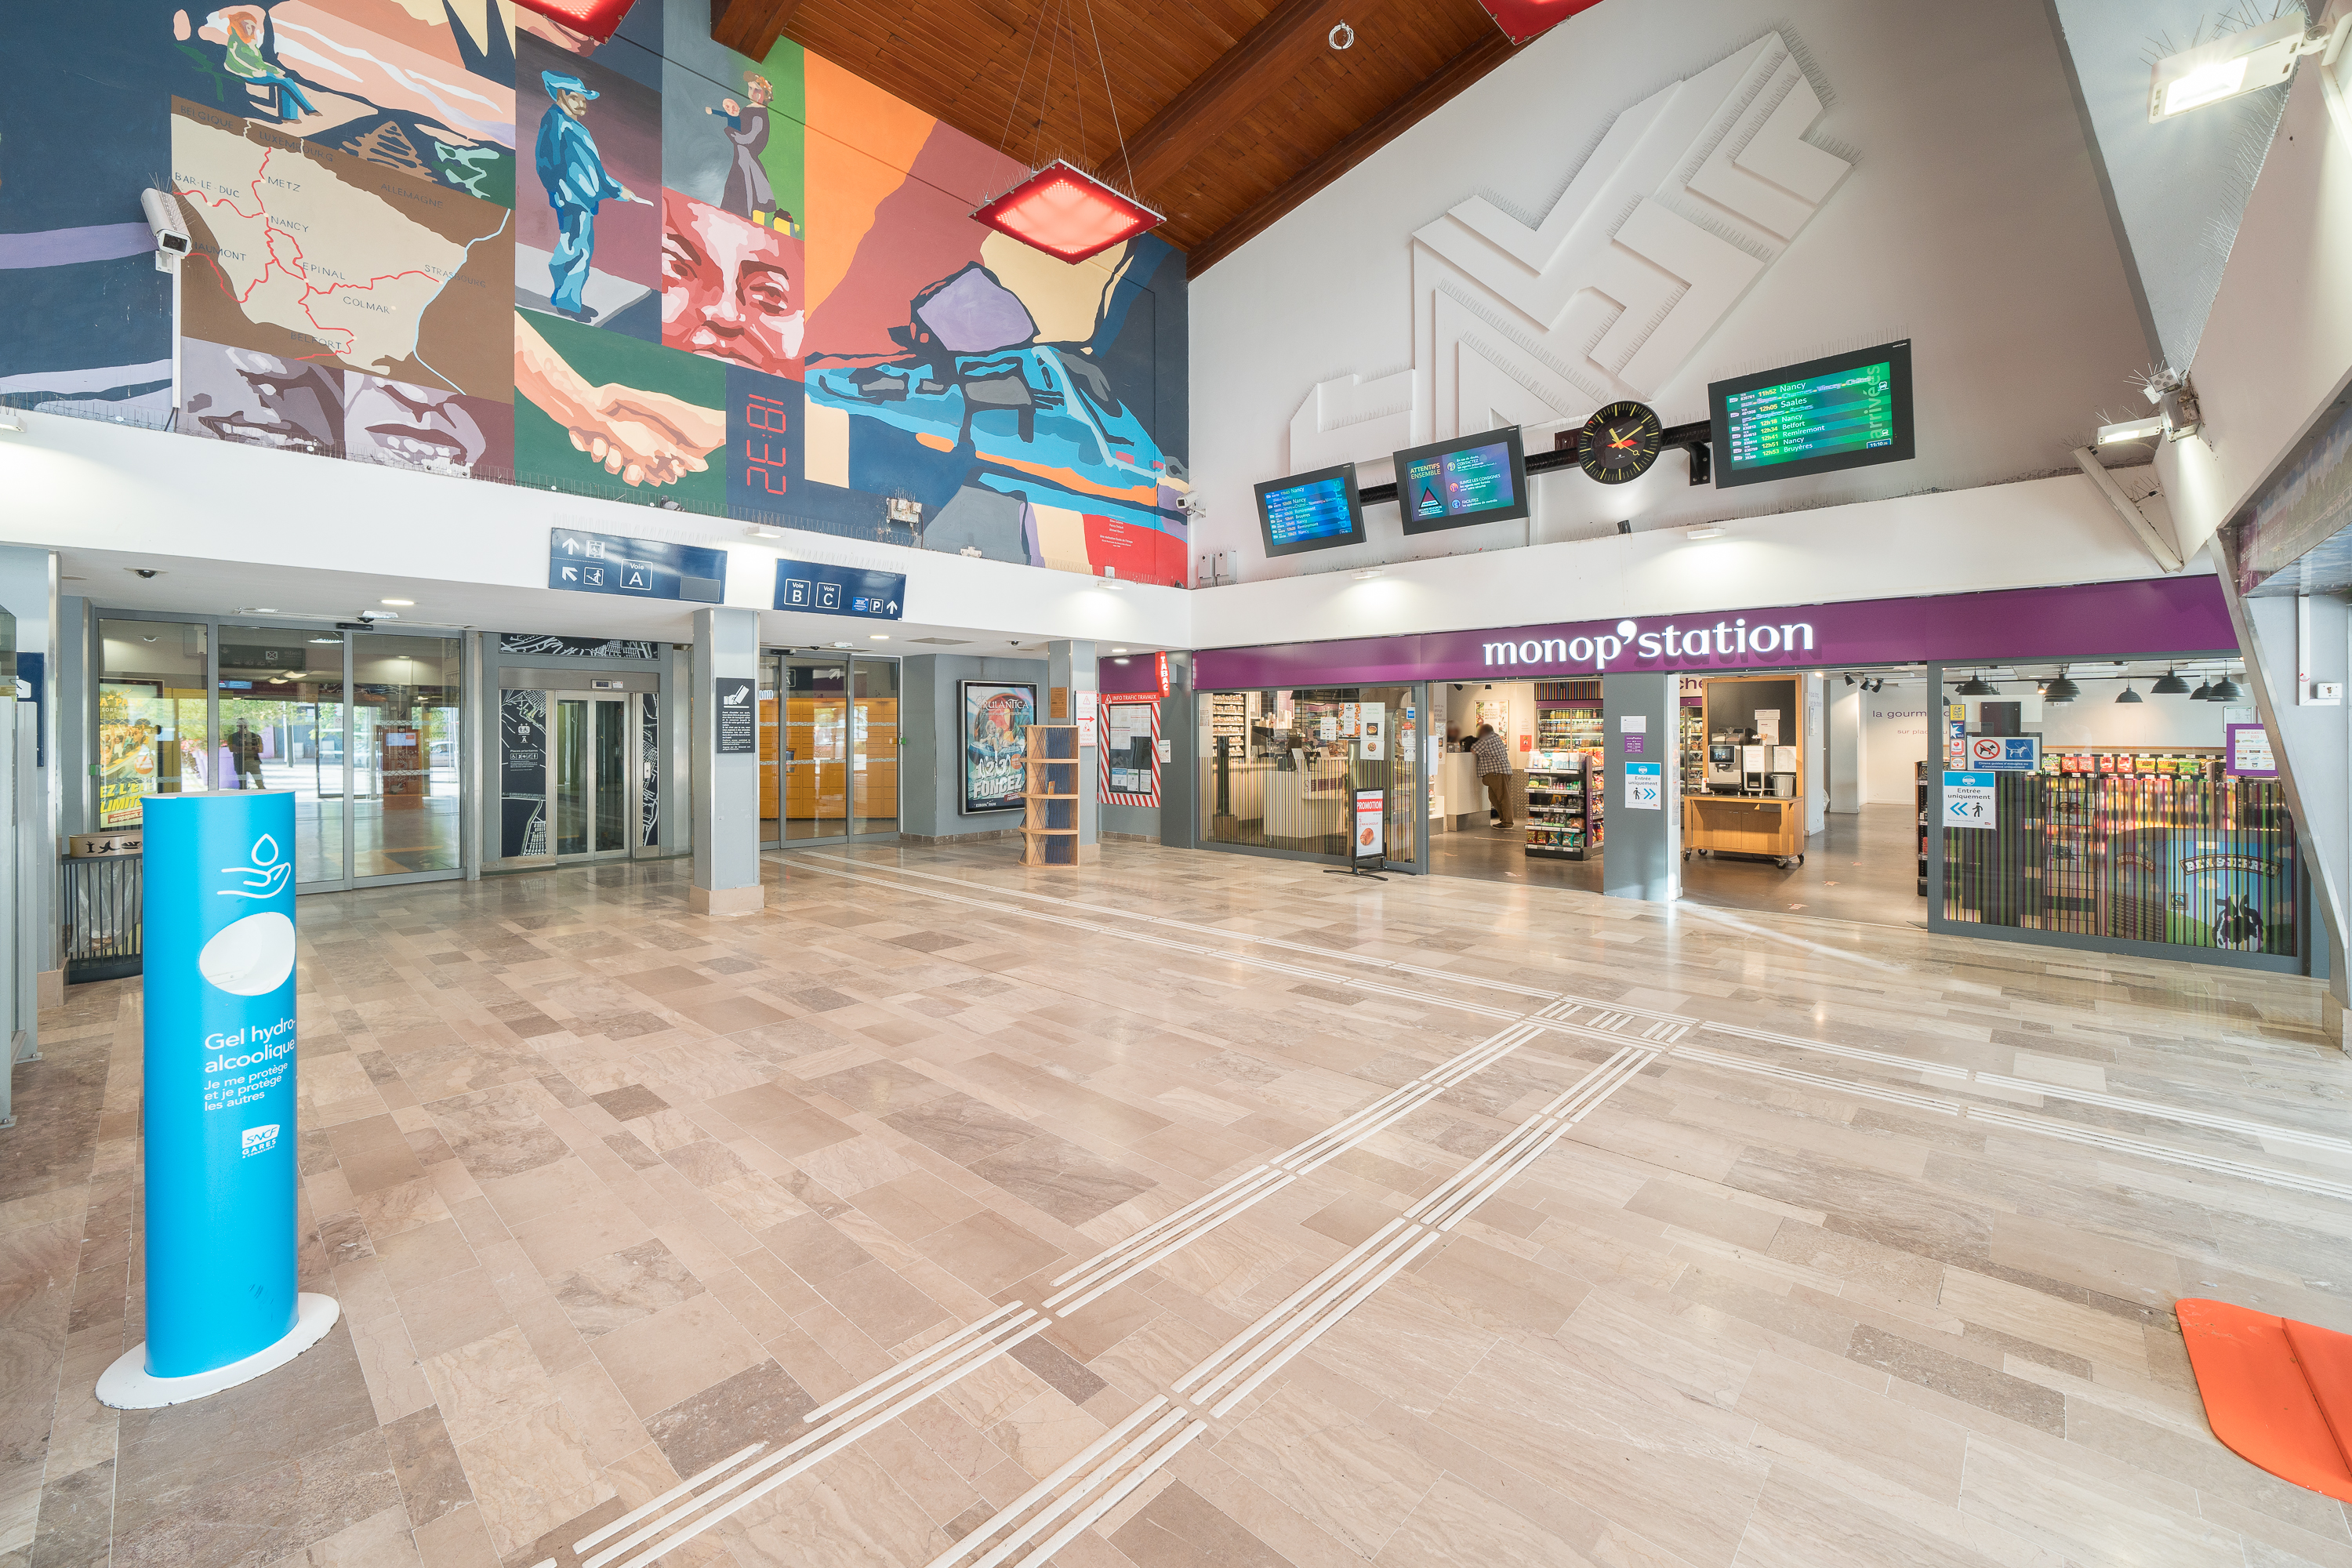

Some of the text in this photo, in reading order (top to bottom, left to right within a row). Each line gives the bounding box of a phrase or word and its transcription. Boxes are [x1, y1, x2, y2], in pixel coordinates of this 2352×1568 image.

[180, 105, 234, 129] BELGIQUE
[260, 131, 333, 162] LUXEMBOURG
[267, 176, 300, 192] METZ
[380, 183, 443, 209] ALLEMAGNE
[270, 216, 309, 232] NANCY
[193, 242, 246, 261] HAUMONT
[303, 262, 345, 280] EPINAL
[424, 264, 486, 288] STRASBOURG
[343, 296, 390, 314] COLMAR
[290, 332, 341, 350] BELFORT
[1780, 383, 1806, 392] Nancy
[1780, 398, 1807, 408] Saales
[1863, 365, 1883, 438] arrivées
[1783, 421, 1805, 430] Belfort
[1783, 425, 1825, 437] Remiremont
[746, 394, 786, 495] 18:32
[1784, 443, 1813, 452] Bruyères
[1410, 463, 1440, 474] ATTENTIFS
[1411, 469, 1441, 479] ENSEMBLE
[1333, 480, 1347, 528] départs
[629, 572, 643, 586] A
[793, 590, 833, 605] B C
[873, 601, 880, 612] P
[1483, 619, 1813, 670] monop'station
[983, 699, 1029, 711] RULANTICA
[974, 774, 1022, 798] FONCEZ
[1357, 801, 1382, 810] PROMOTION
[205, 1018, 296, 1050] Gel hydro-
[205, 1039, 295, 1073] alcoolique
[204, 1063, 288, 1090] Je me protège
[204, 1075, 281, 1101] et je protège
[205, 1091, 265, 1111] les autres
[245, 1127, 278, 1145] SNCF
[242, 1138, 276, 1155] GARES
